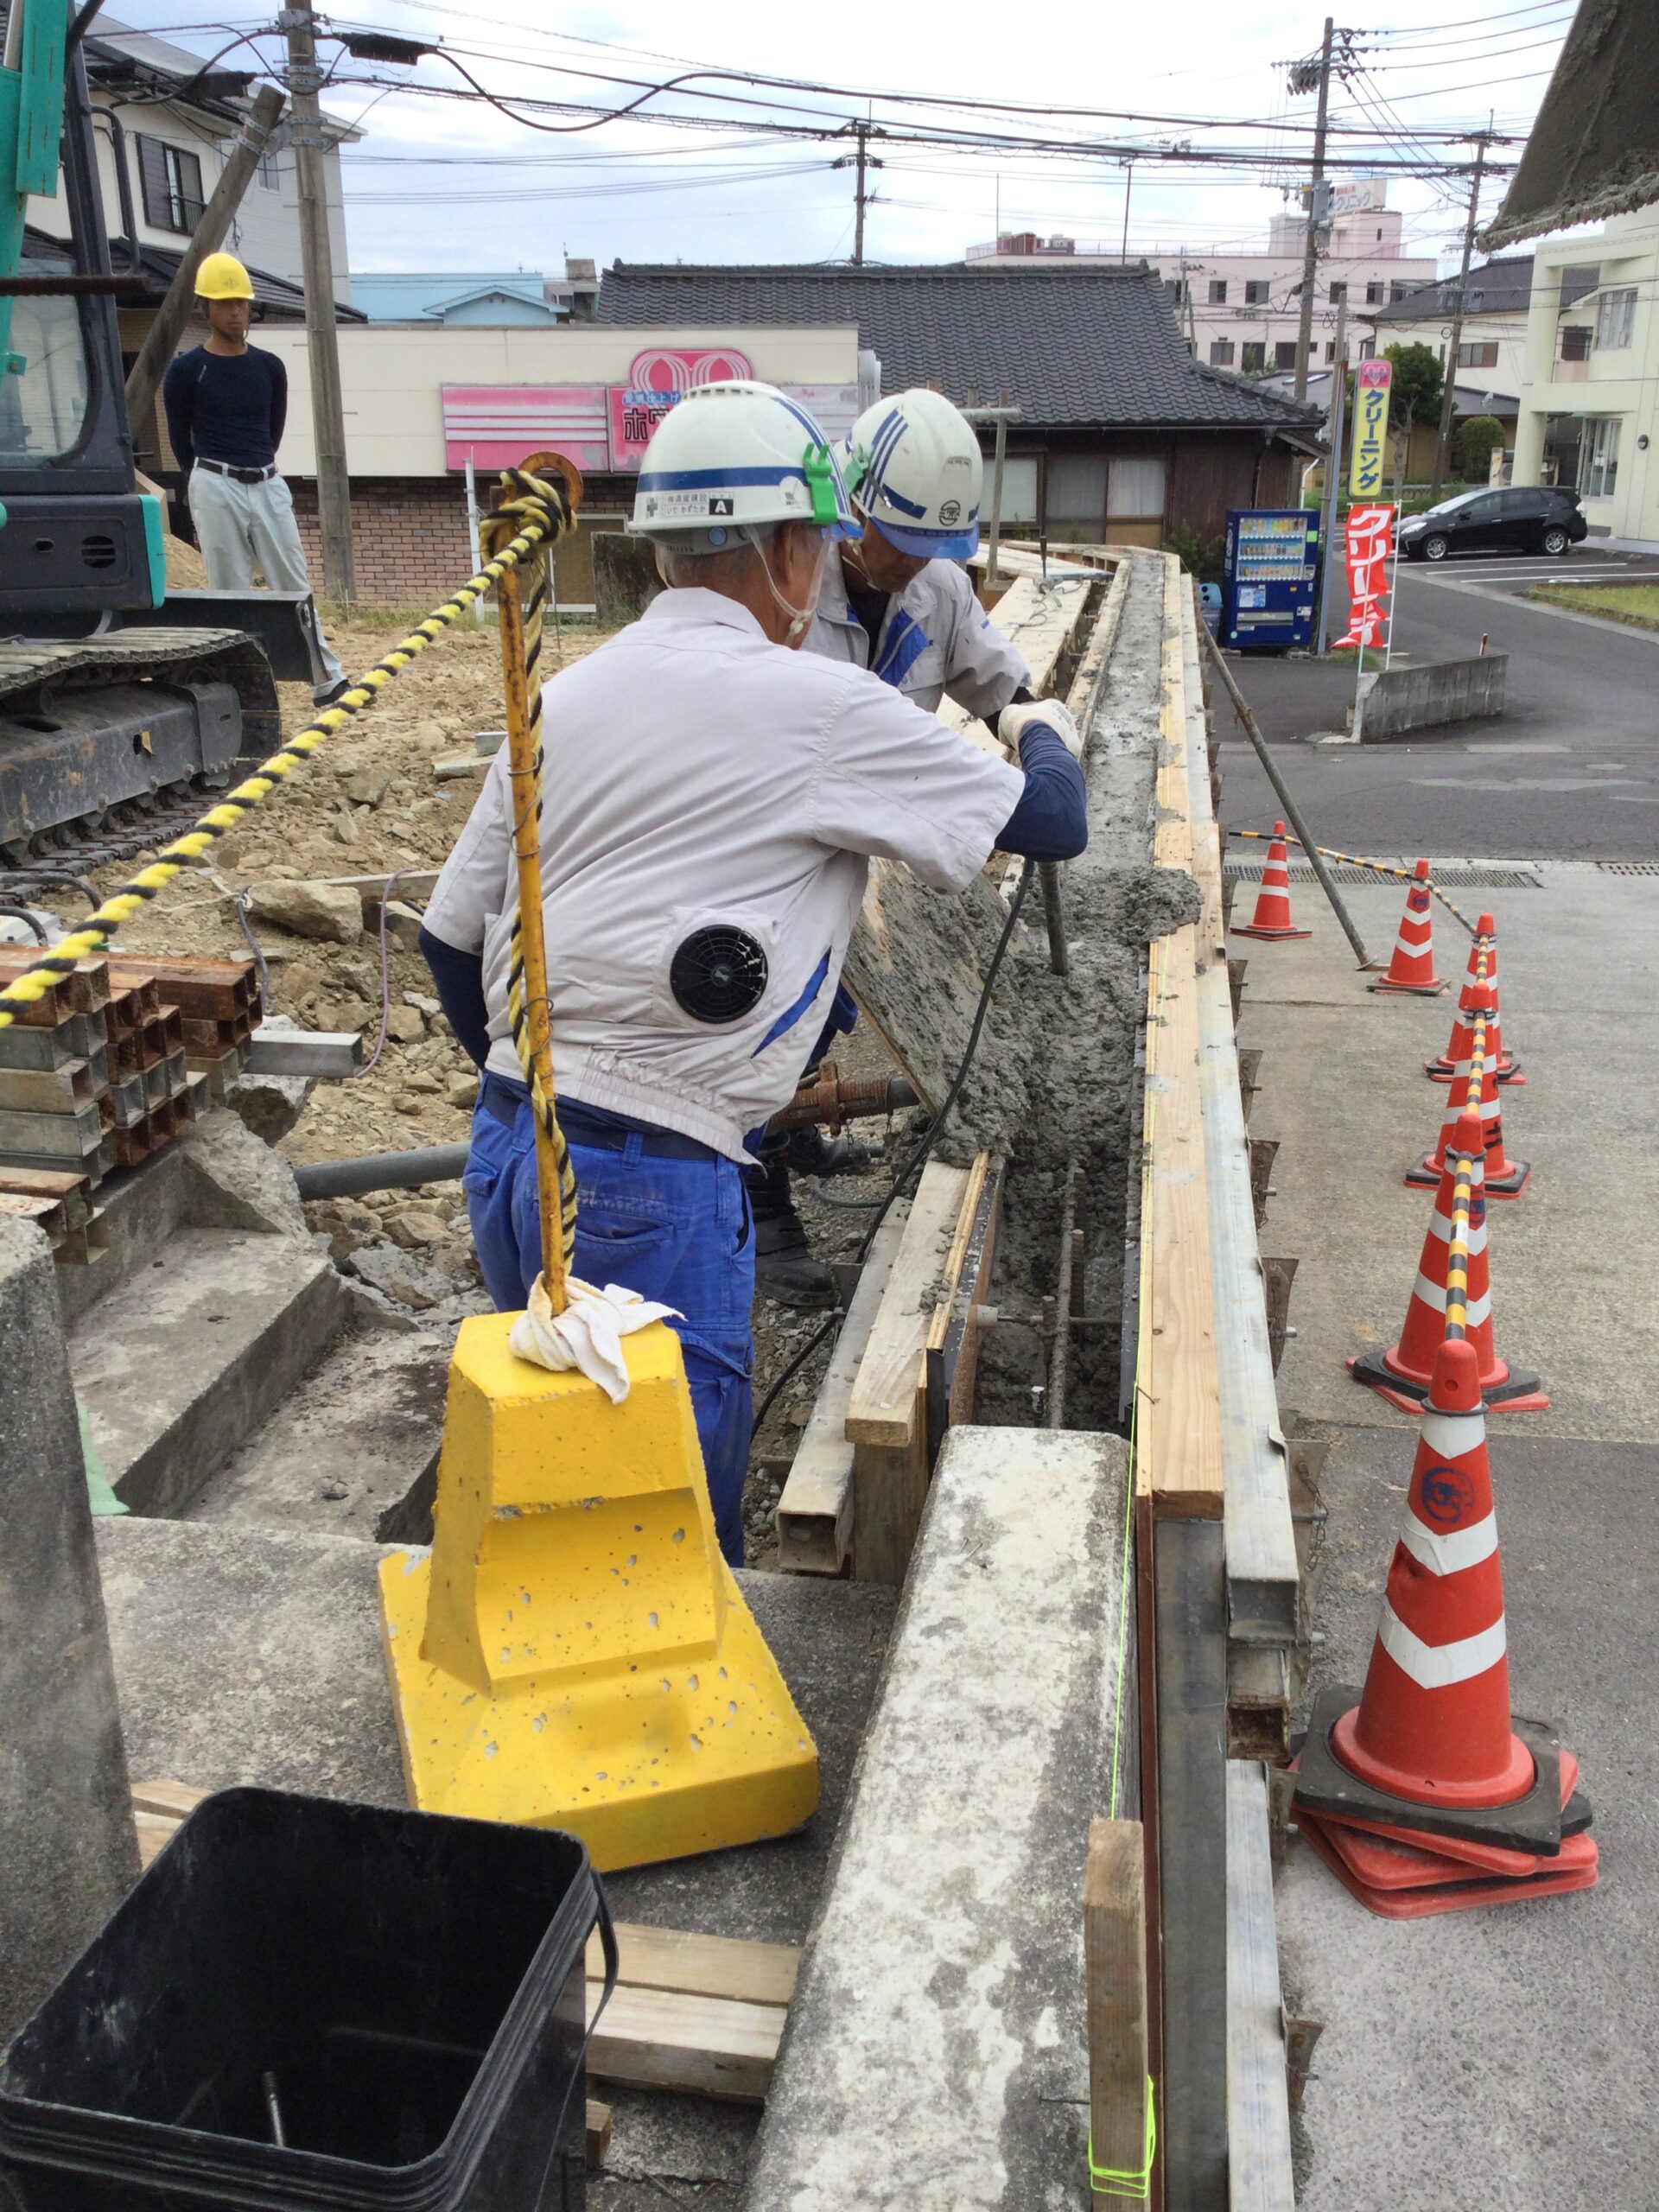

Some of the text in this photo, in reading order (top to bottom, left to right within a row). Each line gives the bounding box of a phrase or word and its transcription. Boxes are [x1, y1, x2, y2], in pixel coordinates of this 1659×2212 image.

[1357, 389, 1384, 490] クリーニング
[715, 499, 728, 514] A
